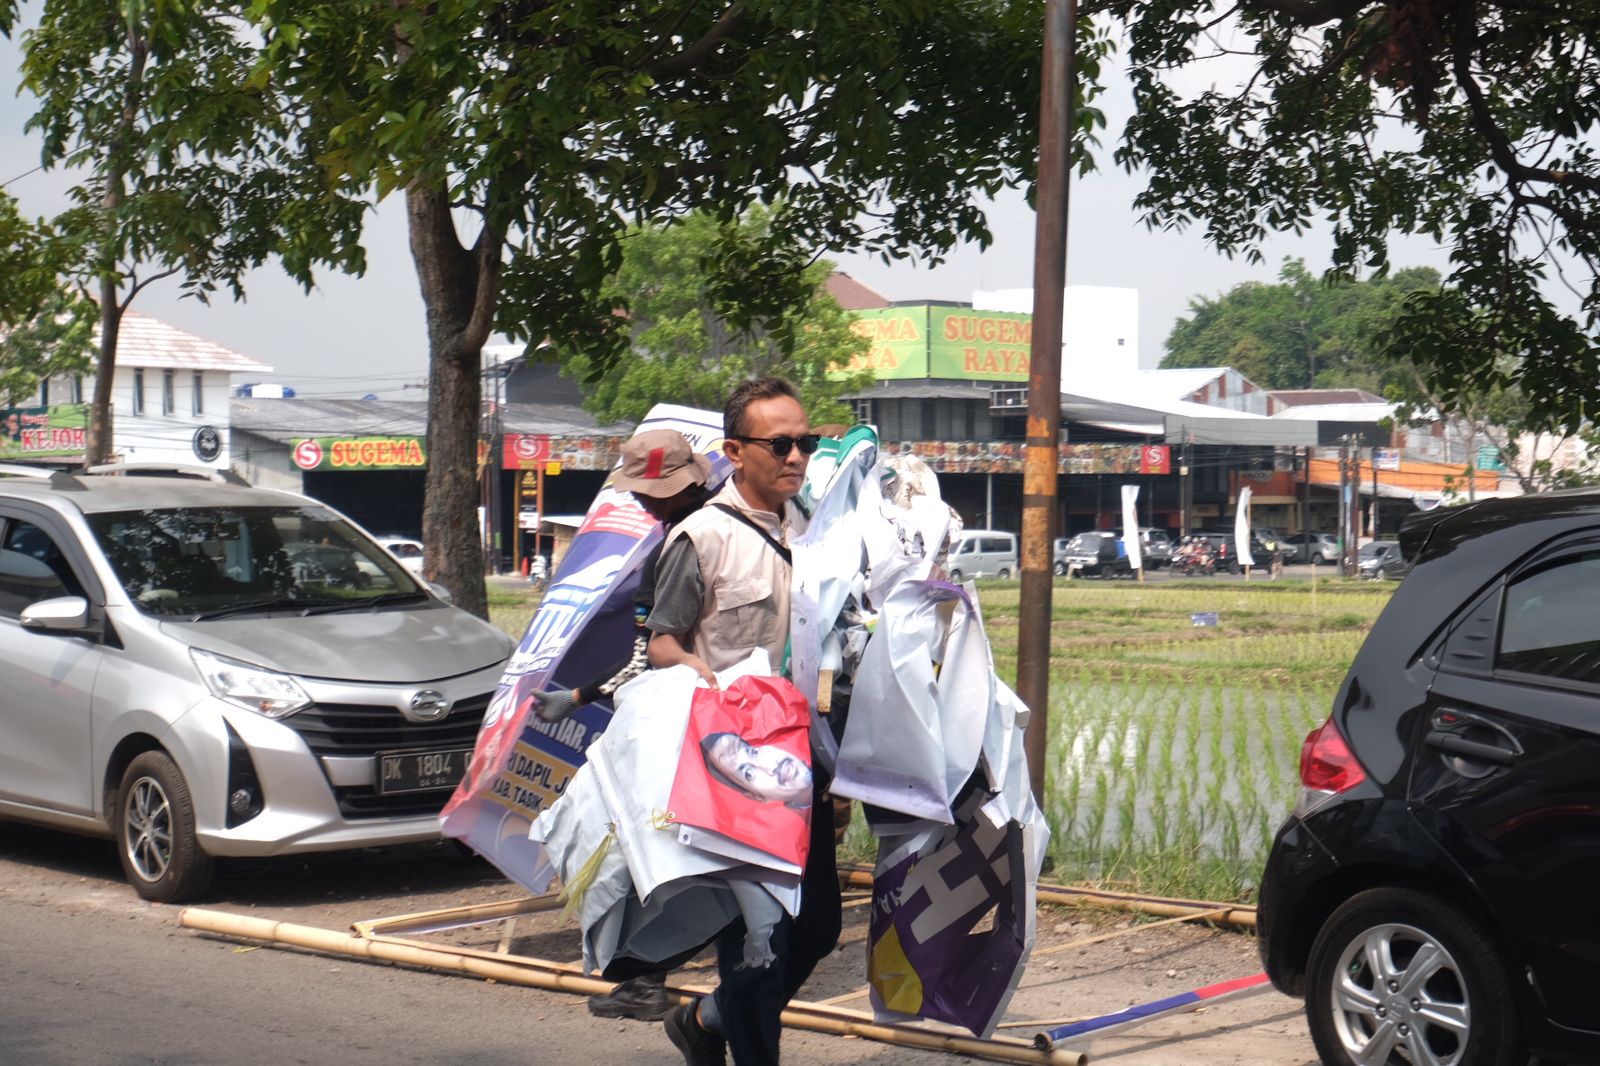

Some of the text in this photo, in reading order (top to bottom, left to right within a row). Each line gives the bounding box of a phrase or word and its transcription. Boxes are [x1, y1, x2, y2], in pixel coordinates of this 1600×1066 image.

[944, 316, 1031, 344] SUGEM
[963, 347, 1030, 375] RAYA
[331, 440, 425, 466] SUGEMA
[384, 757, 402, 780] DK
[416, 753, 452, 777] 1804
[516, 754, 552, 789] DAPIL
